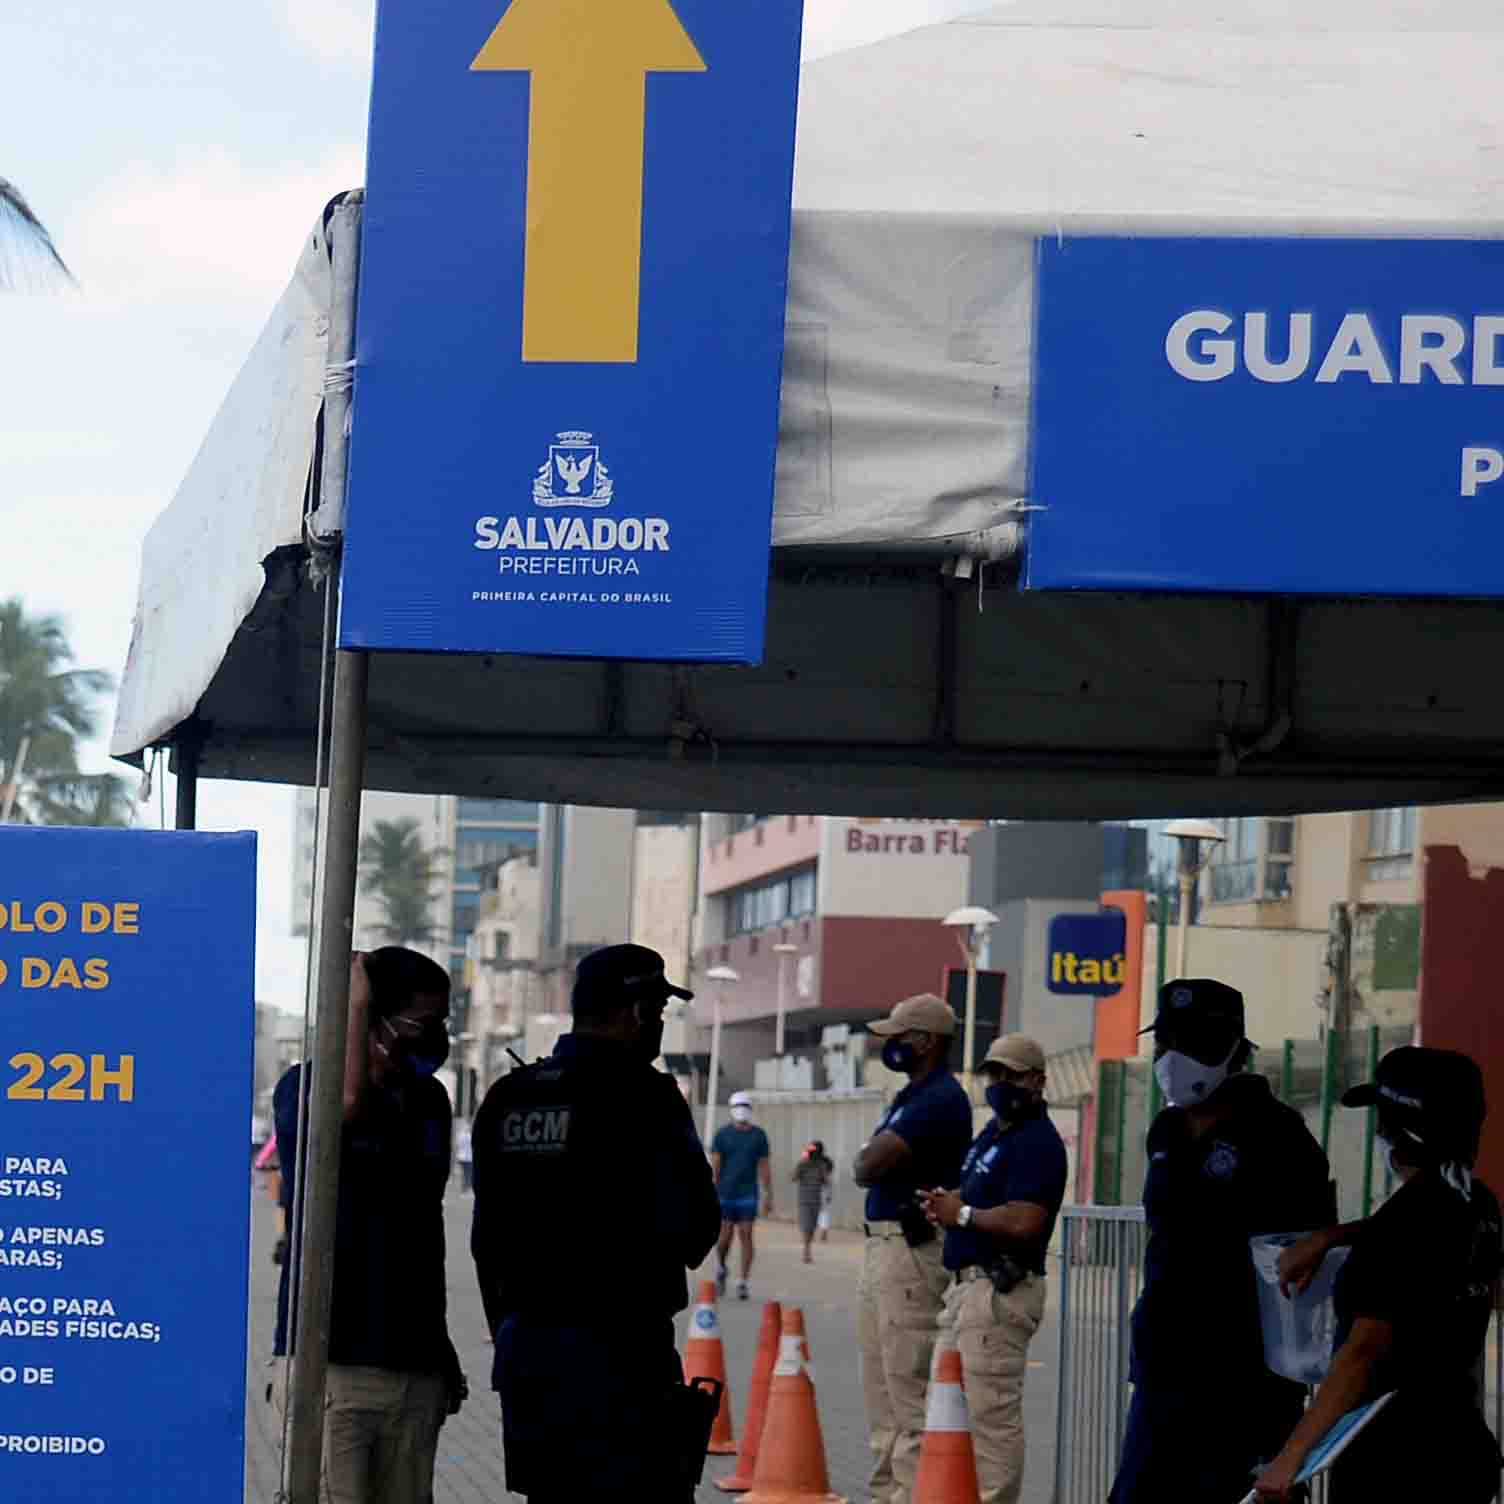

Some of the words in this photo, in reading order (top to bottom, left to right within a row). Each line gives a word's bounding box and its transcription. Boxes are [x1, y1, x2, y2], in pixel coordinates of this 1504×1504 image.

[473, 516, 670, 552] SALVADOR
[499, 556, 640, 576] PREFEITURA
[472, 591, 535, 601] PRIMEIRA
[539, 591, 597, 603] CAPITAL
[600, 592, 620, 603] DO
[624, 592, 672, 603] BRASIL
[846, 829, 925, 854] Barra
[80, 901, 140, 934] DE
[20, 957, 110, 990] DAS
[1050, 947, 1127, 986] Itaú
[7, 1052, 134, 1103] 22H
[503, 1111, 569, 1145] GCM
[5, 1157, 68, 1175] PARA
[10, 1226, 105, 1246] APENAS
[52, 1297, 116, 1317] PARA
[65, 1316, 161, 1343] FÍSICAS;
[23, 1367, 54, 1385] DE
